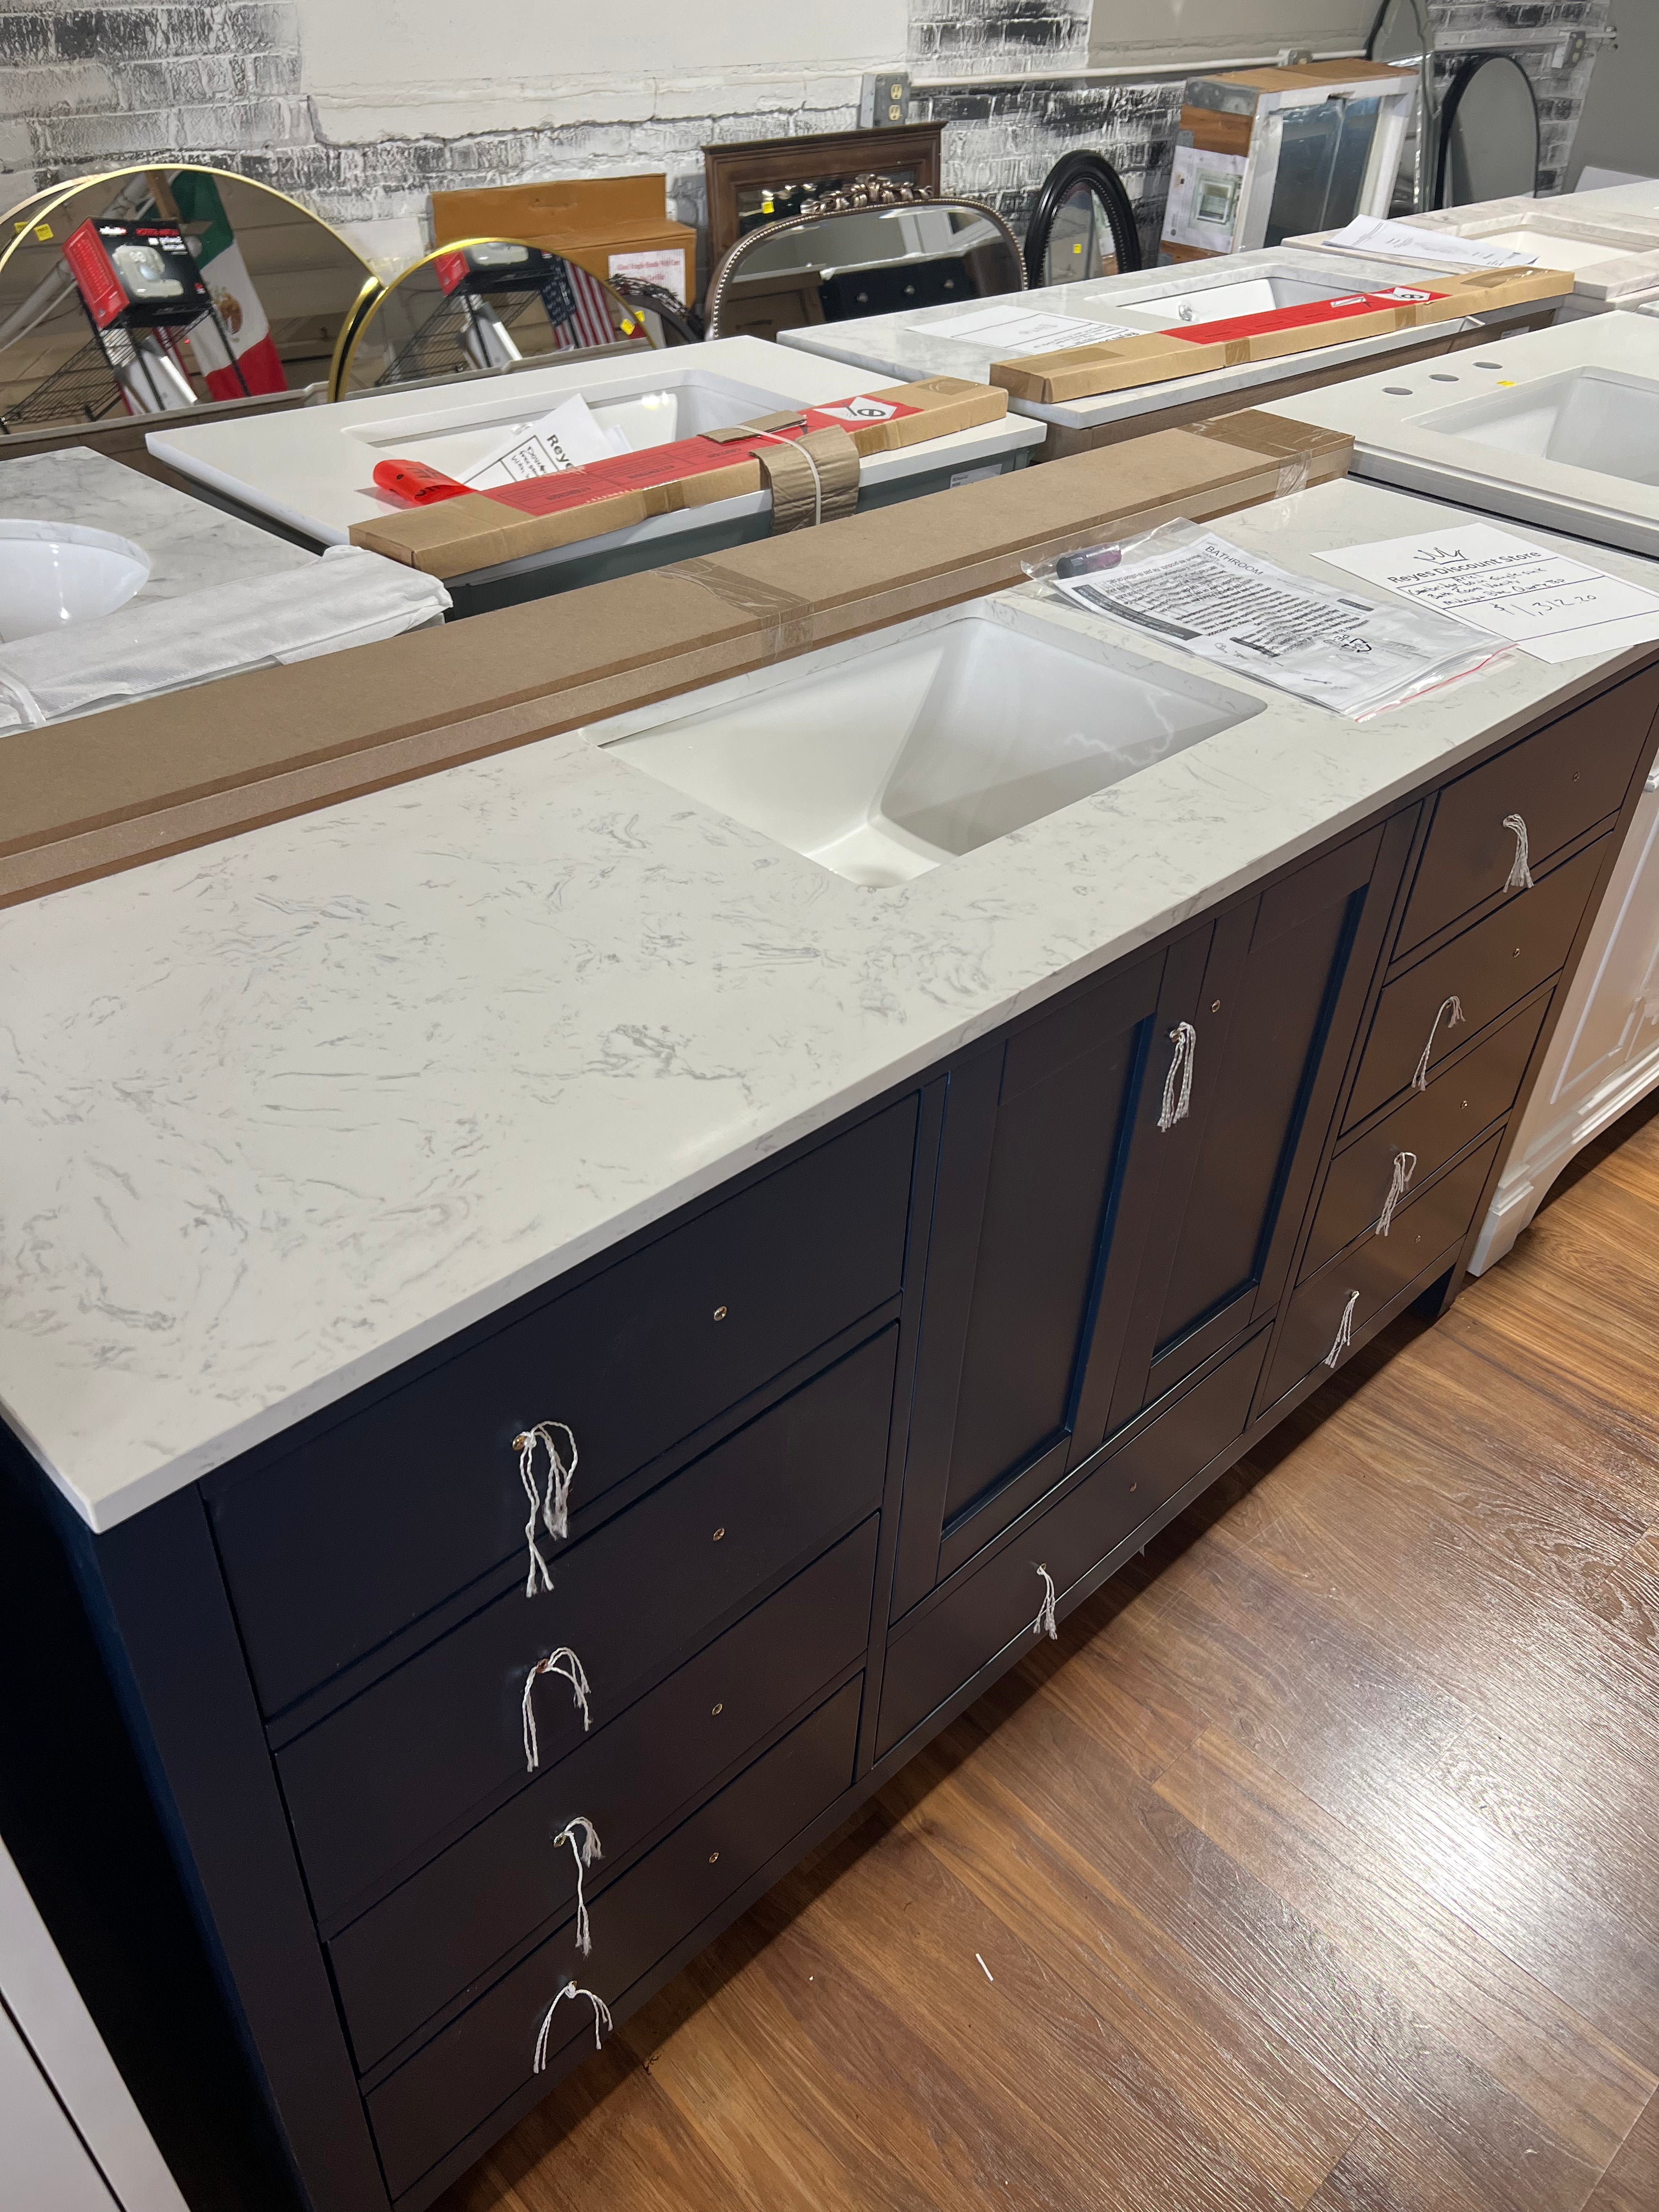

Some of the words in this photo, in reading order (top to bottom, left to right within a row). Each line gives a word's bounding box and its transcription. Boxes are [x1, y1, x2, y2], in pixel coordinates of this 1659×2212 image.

[1205, 546, 1263, 575] BATHROOM
[1387, 571, 1436, 583] Reyes
[1432, 558, 1502, 575] Discount
[1498, 551, 1542, 562] Store
